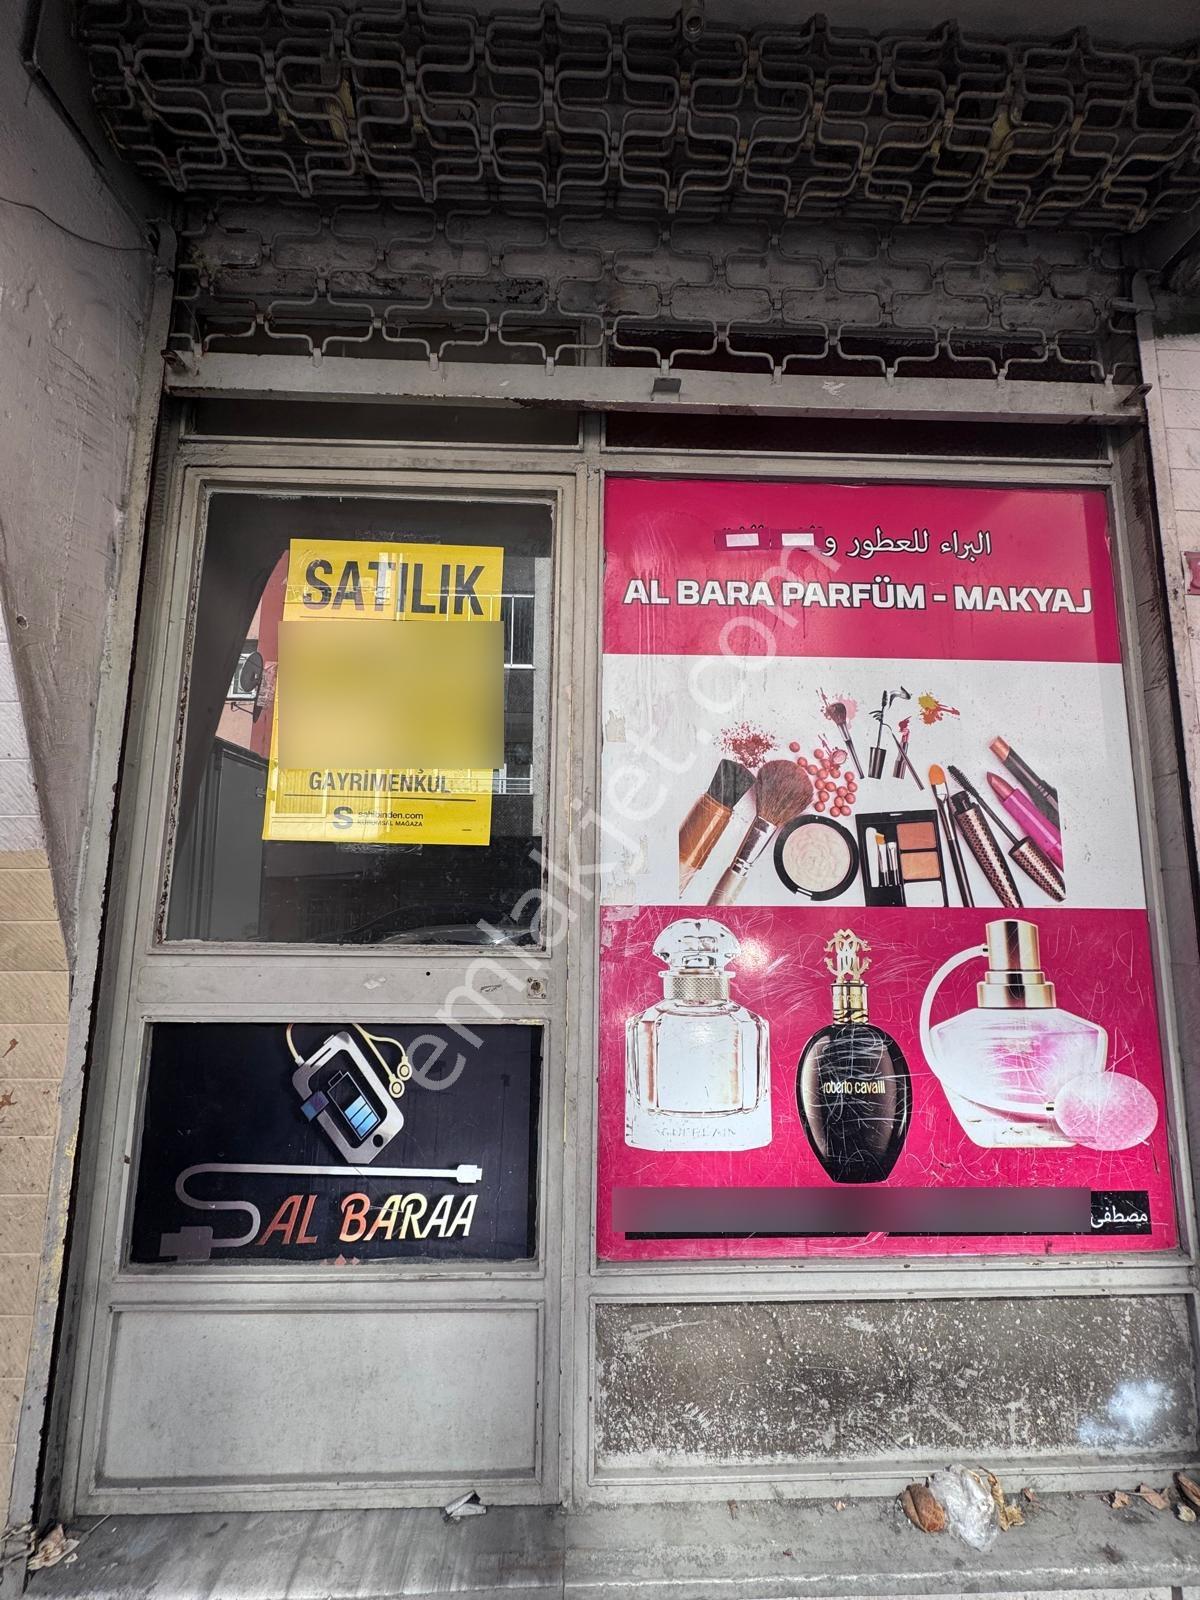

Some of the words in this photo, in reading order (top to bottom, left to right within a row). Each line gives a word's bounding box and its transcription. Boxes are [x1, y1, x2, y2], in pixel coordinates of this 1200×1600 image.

[847, 526, 930, 560] للعطور
[939, 531, 992, 563] البراء
[303, 559, 485, 615] SATILIK
[623, 578, 670, 606] AL
[676, 580, 770, 607] BARA
[782, 575, 926, 611] PARFÜM
[954, 587, 1093, 614] MAKYAJ
[823, 1080, 853, 1094] roberto
[854, 1080, 886, 1094] cavalli
[257, 1194, 318, 1245] AL
[338, 1192, 479, 1242] BARAA
